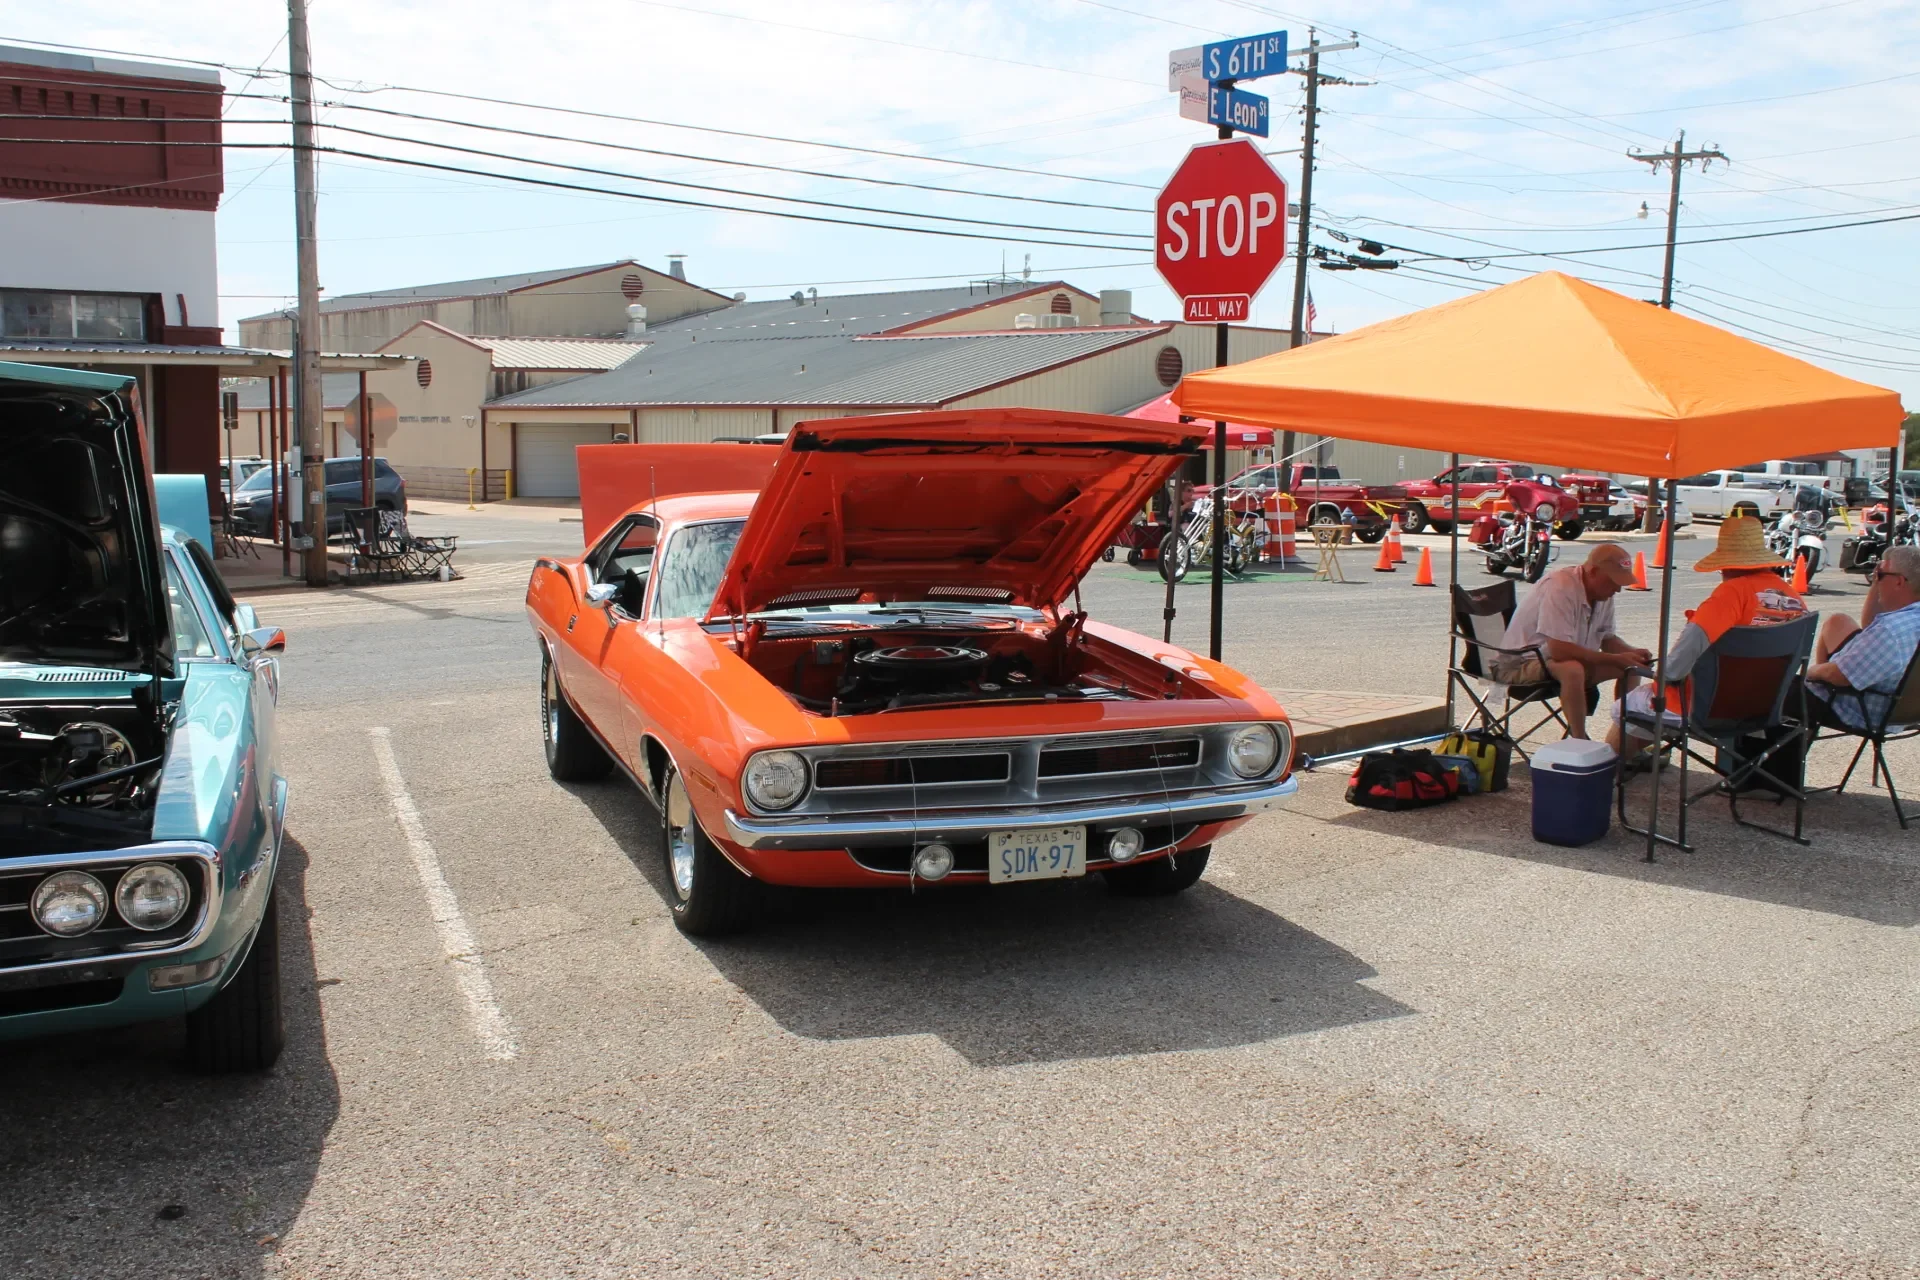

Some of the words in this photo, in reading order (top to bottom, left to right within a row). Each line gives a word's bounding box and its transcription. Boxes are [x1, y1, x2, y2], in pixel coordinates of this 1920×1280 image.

[1209, 48, 1221, 79] S
[1228, 39, 1266, 76] 6TH
[1268, 37, 1280, 54] St
[1210, 88, 1219, 119] E
[1225, 92, 1258, 129] Leon
[1259, 101, 1267, 117] St
[1163, 192, 1278, 262] STOP
[1189, 301, 1213, 318] ALL
[1218, 300, 1243, 317] WAY
[1019, 832, 1059, 845] TEXAS
